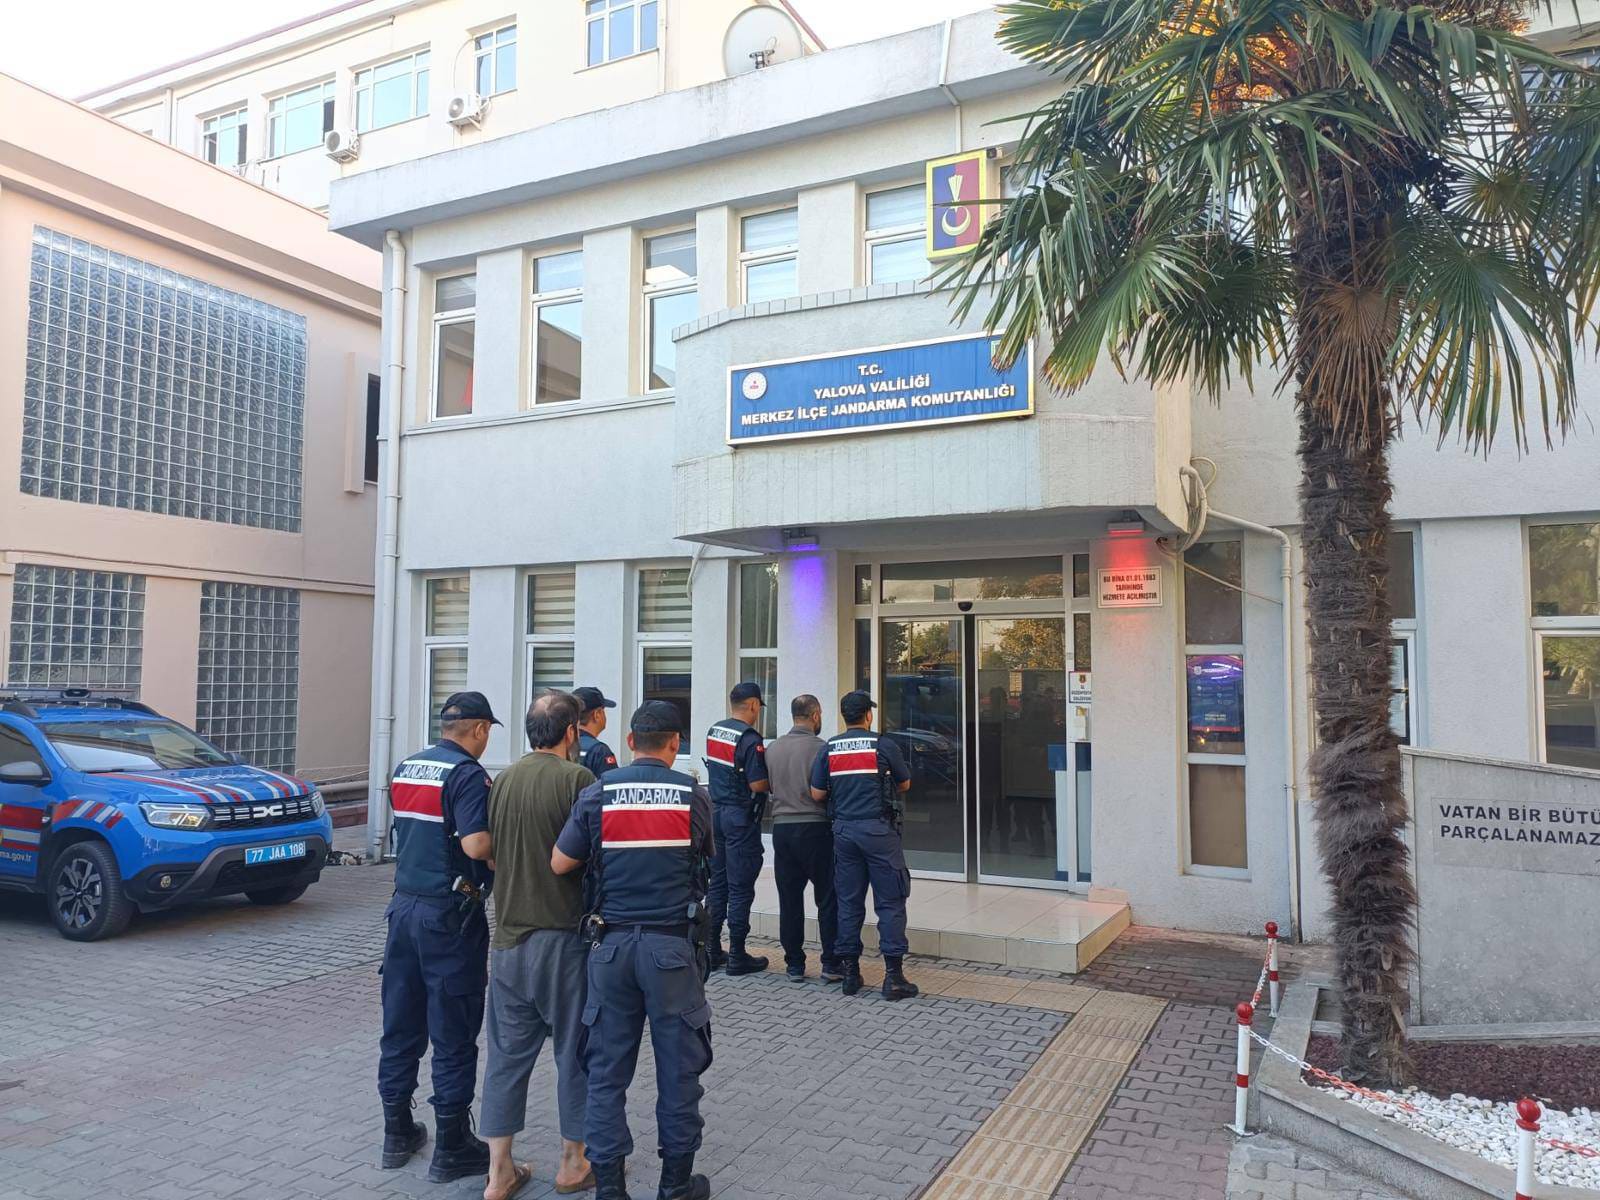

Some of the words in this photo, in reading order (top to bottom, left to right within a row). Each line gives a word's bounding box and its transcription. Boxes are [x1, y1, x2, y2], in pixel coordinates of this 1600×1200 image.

[857, 363, 884, 376] T.C.
[814, 382, 866, 400] YALOVA
[870, 373, 930, 393] VALİLİĞİ
[741, 409, 795, 426] MERKEZ
[797, 407, 828, 421] İLÇE
[831, 399, 907, 416] JANDARMA
[911, 384, 1015, 407] KOMUTANLIĞI
[833, 740, 872, 752] JANDARMA
[400, 764, 444, 781] JANDARMA
[611, 788, 682, 805] JANDARMA
[1439, 804, 1500, 820] VATAN
[1508, 804, 1541, 823] BİR
[1440, 825, 1600, 846] PARÇALANAMAZ
[251, 849, 265, 863] 77
[269, 845, 286, 860] JAA
[289, 842, 304, 856] 108
